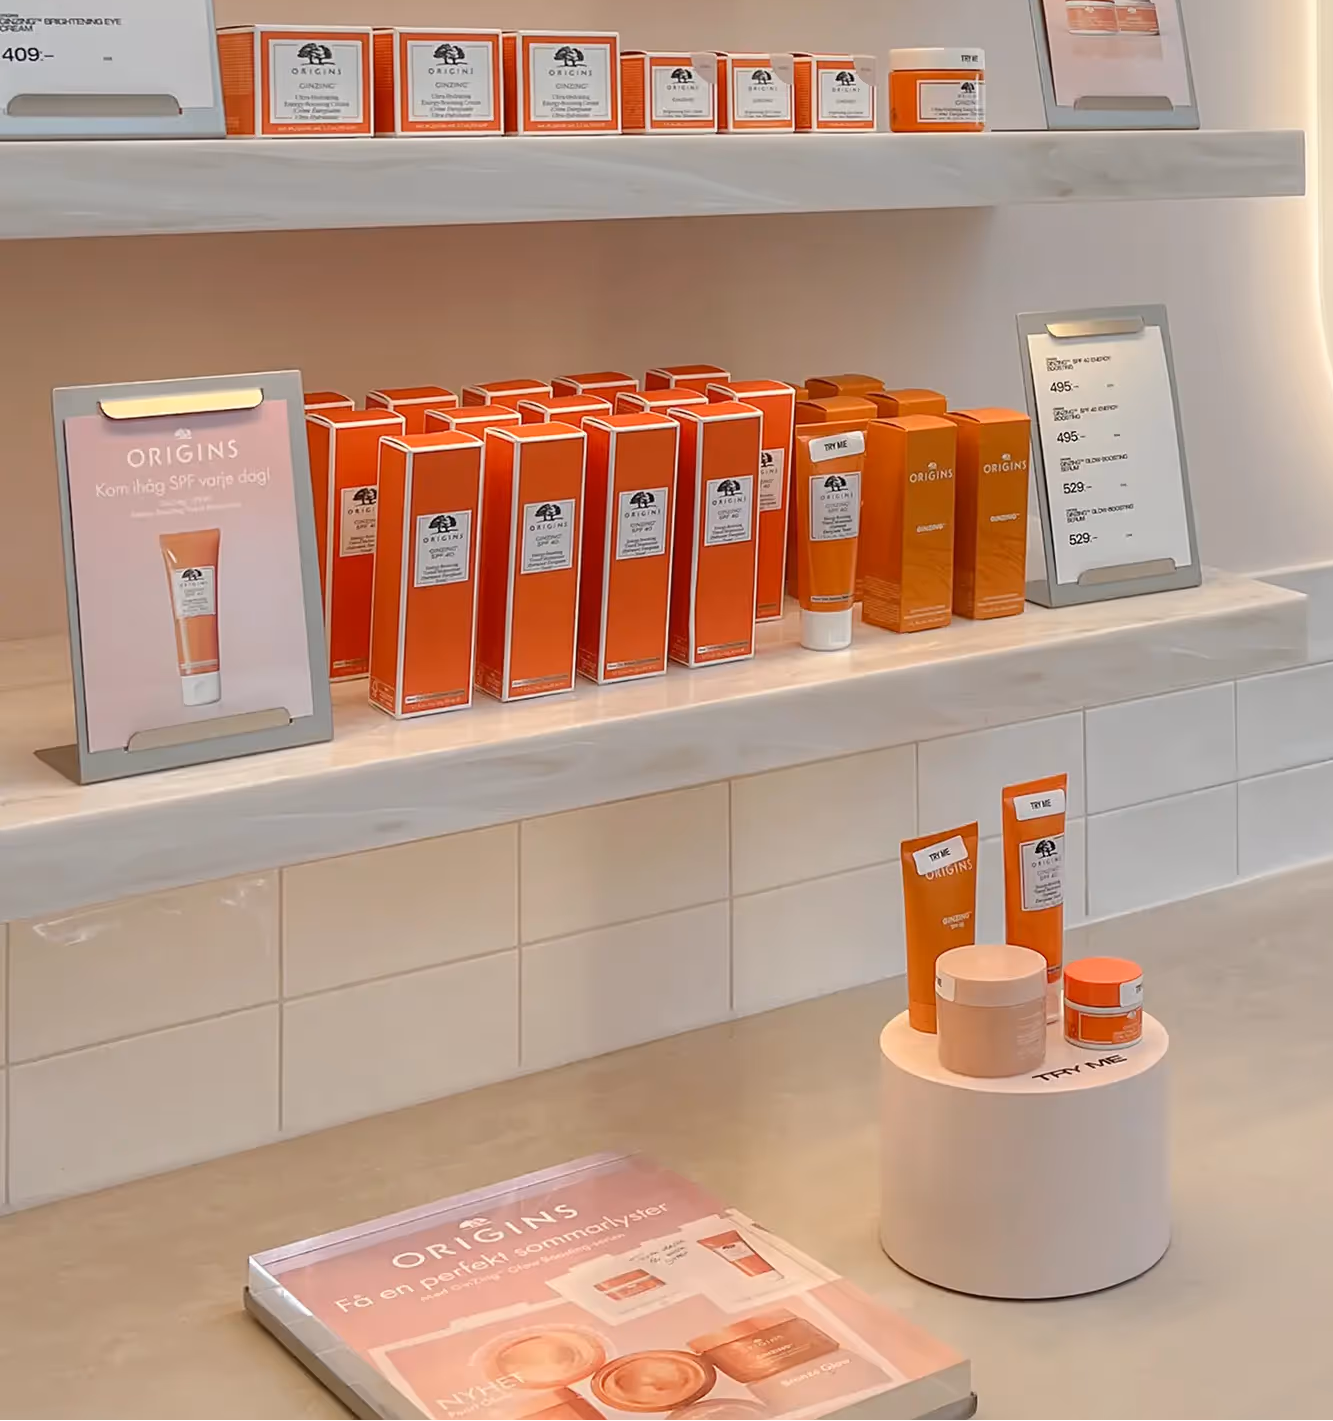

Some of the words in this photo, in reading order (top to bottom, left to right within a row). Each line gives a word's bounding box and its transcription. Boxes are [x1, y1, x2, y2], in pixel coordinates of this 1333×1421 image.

[291, 67, 342, 76] ORIGINS
[548, 69, 592, 77] ORIGINS
[127, 439, 240, 469] ORIGINS
[910, 468, 953, 484] ORIGINS
[983, 459, 1026, 474] ORIGINS
[95, 482, 130, 498] Kom
[133, 478, 166, 497] ihåg
[169, 474, 197, 493] SPF
[198, 474, 234, 493] varje
[530, 522, 568, 531] ORIGINS
[423, 534, 464, 544] ORIGINS
[929, 852, 940, 862] TRY
[926, 858, 973, 881] ORIGINS
[1032, 1064, 1081, 1083] TRY
[1087, 1054, 1128, 1071] ME
[392, 1204, 579, 1269] ORIGINS
[335, 1293, 374, 1314] Få
[380, 1282, 414, 1301] en
[419, 1251, 510, 1292] perfekt
[514, 1202, 668, 1258] sommarlyster
[435, 1371, 527, 1411] NYHET
